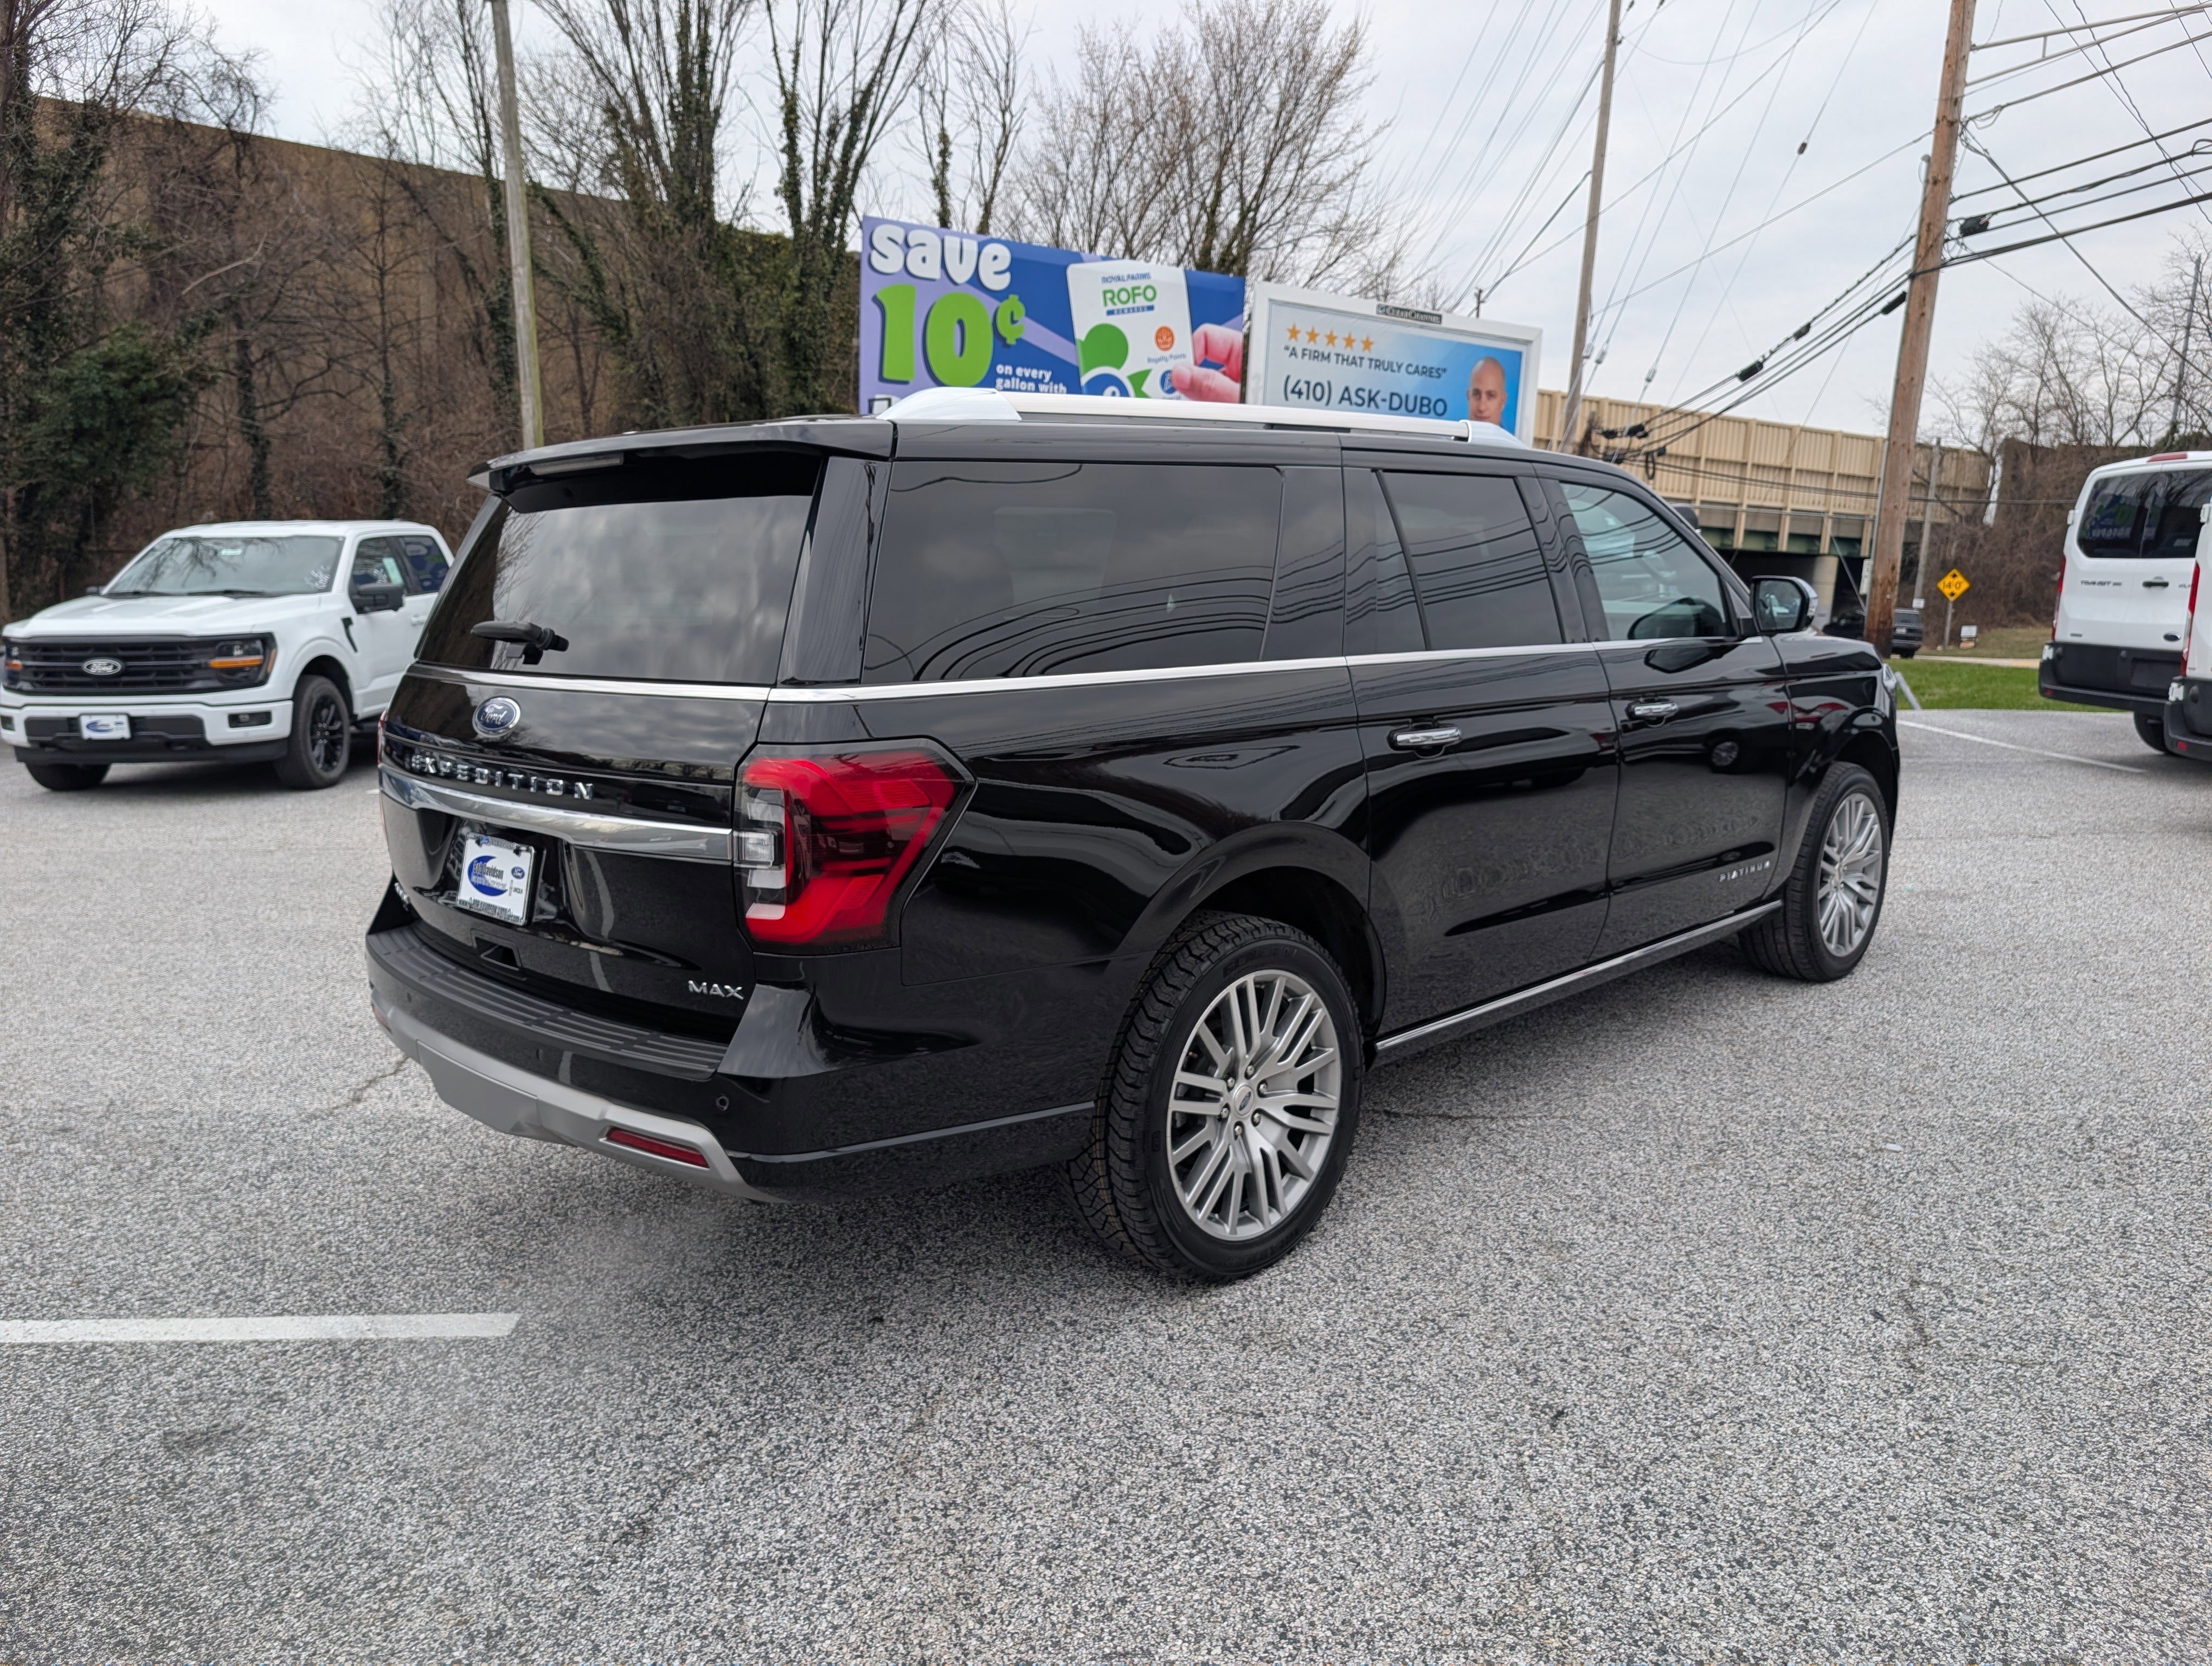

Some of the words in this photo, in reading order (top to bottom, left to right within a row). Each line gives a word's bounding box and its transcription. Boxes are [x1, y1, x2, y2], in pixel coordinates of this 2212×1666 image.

[870, 224, 1012, 291] save
[1103, 285, 1156, 306] ROFO
[1301, 348, 1331, 363] FIRM
[1335, 353, 1364, 368] THAT
[1367, 357, 1404, 373] TRULY
[995, 363, 1013, 375] on
[1015, 366, 1052, 382] every
[995, 377, 1036, 390] gallon
[1038, 381, 1067, 394] with
[1283, 375, 1332, 406] (410)
[1339, 386, 1448, 416] ASK-DUBO
[480, 703, 507, 725] Ford
[411, 754, 594, 800] EXPEDITION
[687, 980, 744, 1000] MAX
